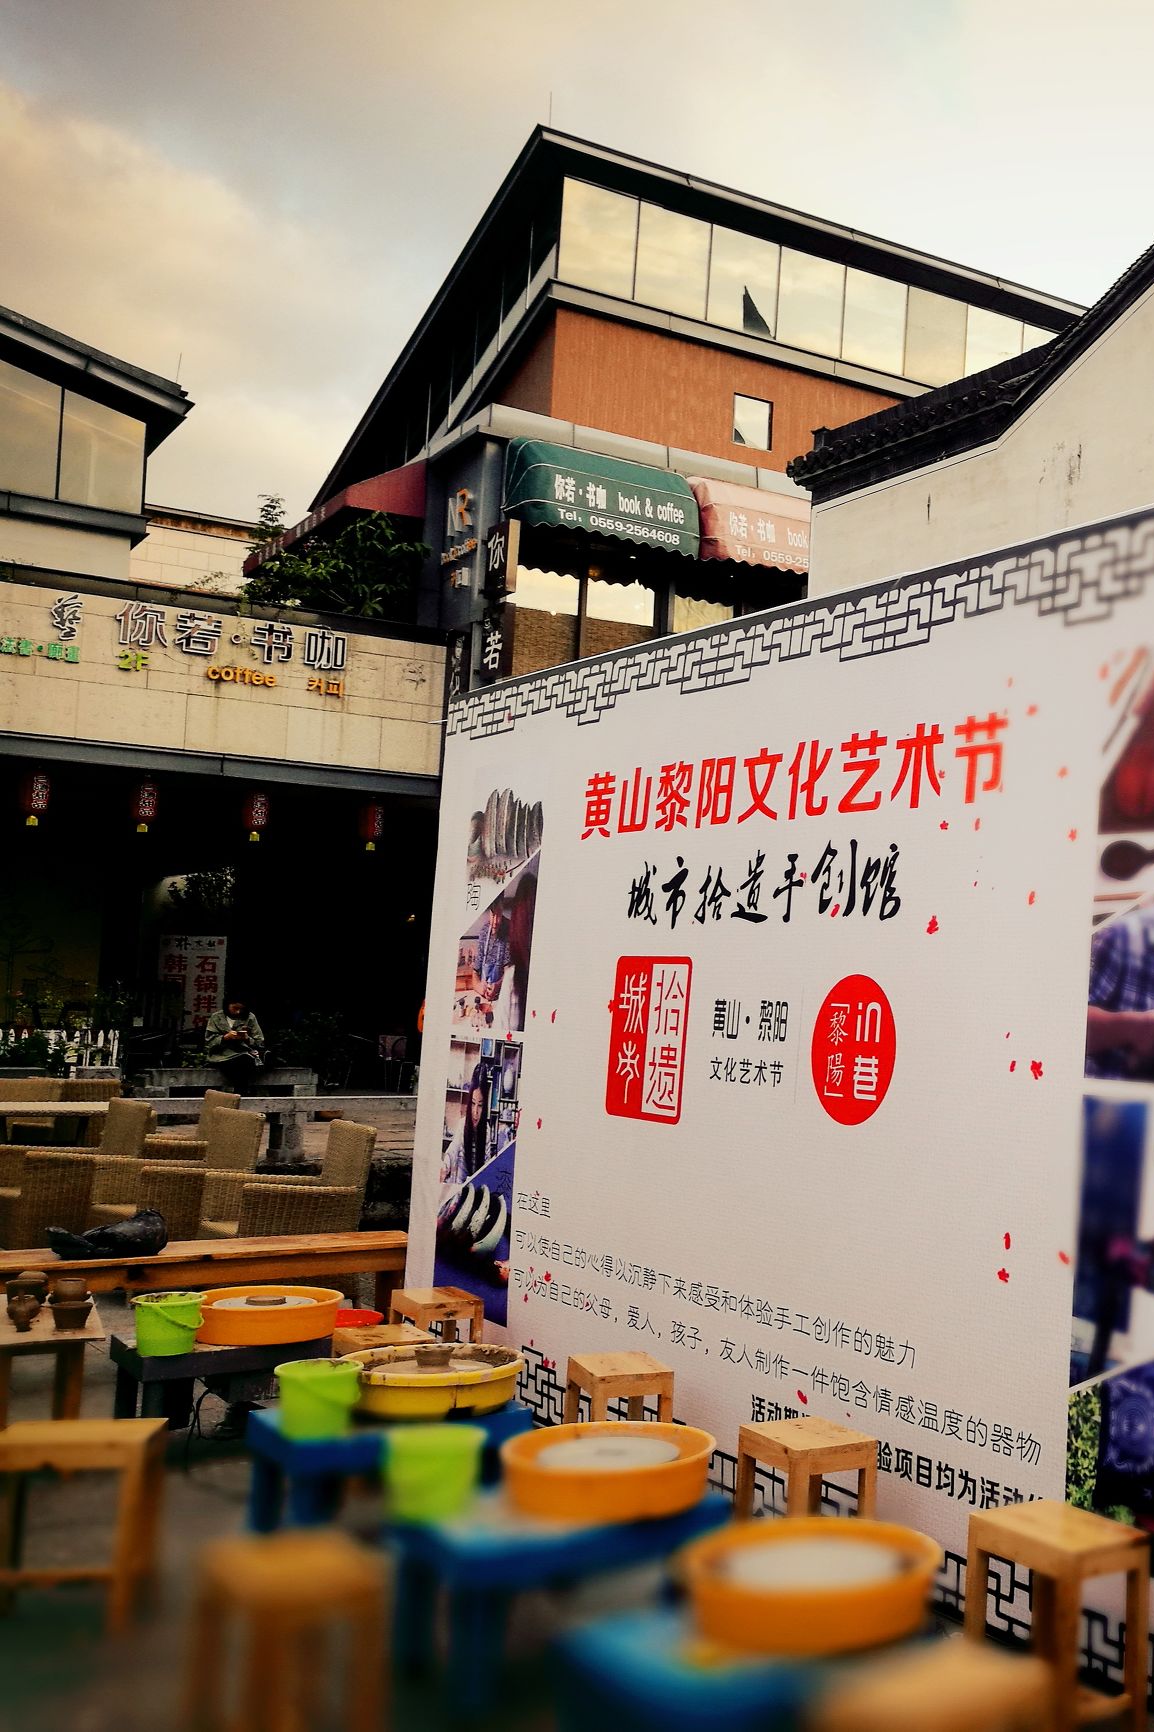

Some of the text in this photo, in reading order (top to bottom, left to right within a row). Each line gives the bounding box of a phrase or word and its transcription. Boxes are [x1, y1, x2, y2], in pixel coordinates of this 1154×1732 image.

[617, 491, 642, 516] book
[645, 498, 654, 518] &
[656, 502, 685, 525] coffee
[589, 515, 680, 545] 0559-2564608
[787, 527, 808, 548] book
[487, 532, 505, 572] 你
[117, 649, 150, 671] 2F
[483, 630, 503, 670] 若
[207, 665, 277, 687] coffee
[307, 677, 345, 698] 커피
[581, 711, 1009, 840] 黄山黎阳文化艺术节
[709, 1056, 784, 1088] 文化艺术节
[852, 1054, 879, 1101] 巷
[516, 1191, 551, 1219] 在这里
[515, 1229, 917, 1370] 可以使自己的心得以沉静下来感受和体验手工创作的魅力
